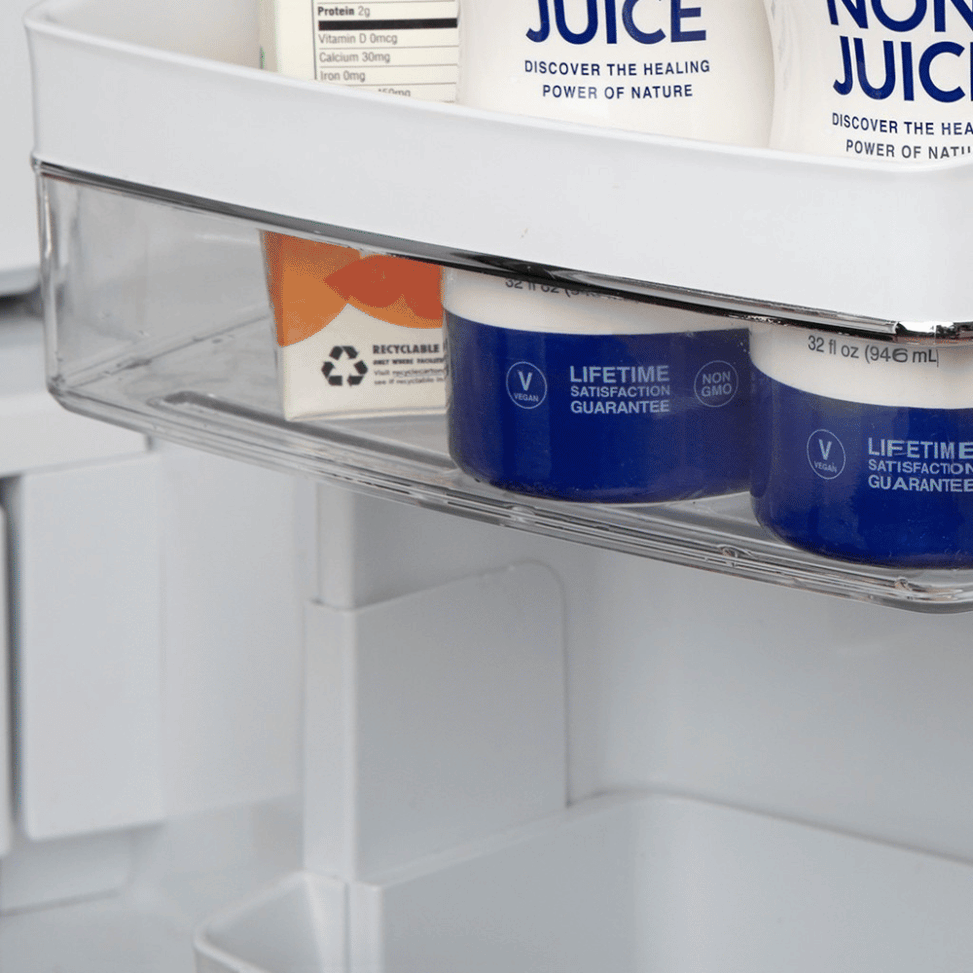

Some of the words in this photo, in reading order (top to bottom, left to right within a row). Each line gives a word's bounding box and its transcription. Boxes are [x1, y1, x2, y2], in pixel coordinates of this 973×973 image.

[318, 7, 354, 17] Protein
[358, 7, 370, 17] 2g
[318, 34, 356, 45] Vitamin
[359, 34, 366, 44] D
[370, 33, 398, 45] 0mcg
[320, 52, 359, 63] Calcium
[362, 51, 390, 63] 30mg
[524, 59, 601, 77] DISCOVER
[607, 63, 637, 76] THE
[644, 59, 710, 76] HEALING
[320, 71, 340, 81] Iron
[342, 71, 366, 83] 0mg
[542, 85, 598, 99] POWER
[604, 86, 624, 99] OF
[631, 84, 693, 99] NATURE
[832, 113, 898, 134] DISCOVER
[904, 121, 935, 135] THE
[846, 139, 896, 158] POWER
[901, 145, 922, 159] OF
[372, 344, 440, 354] RECYCLABLE
[808, 335, 825, 353] 32
[828, 336, 837, 355] fl
[841, 342, 859, 359] oz
[865, 347, 909, 365] (946
[570, 365, 670, 383] LIFETIME
[702, 371, 732, 385] NON
[513, 392, 540, 403] VEGAN
[570, 385, 670, 397] SATISFACTION
[701, 383, 732, 398] GMO
[570, 400, 670, 415] GUARANTEE
[814, 461, 838, 475] VEGAN
